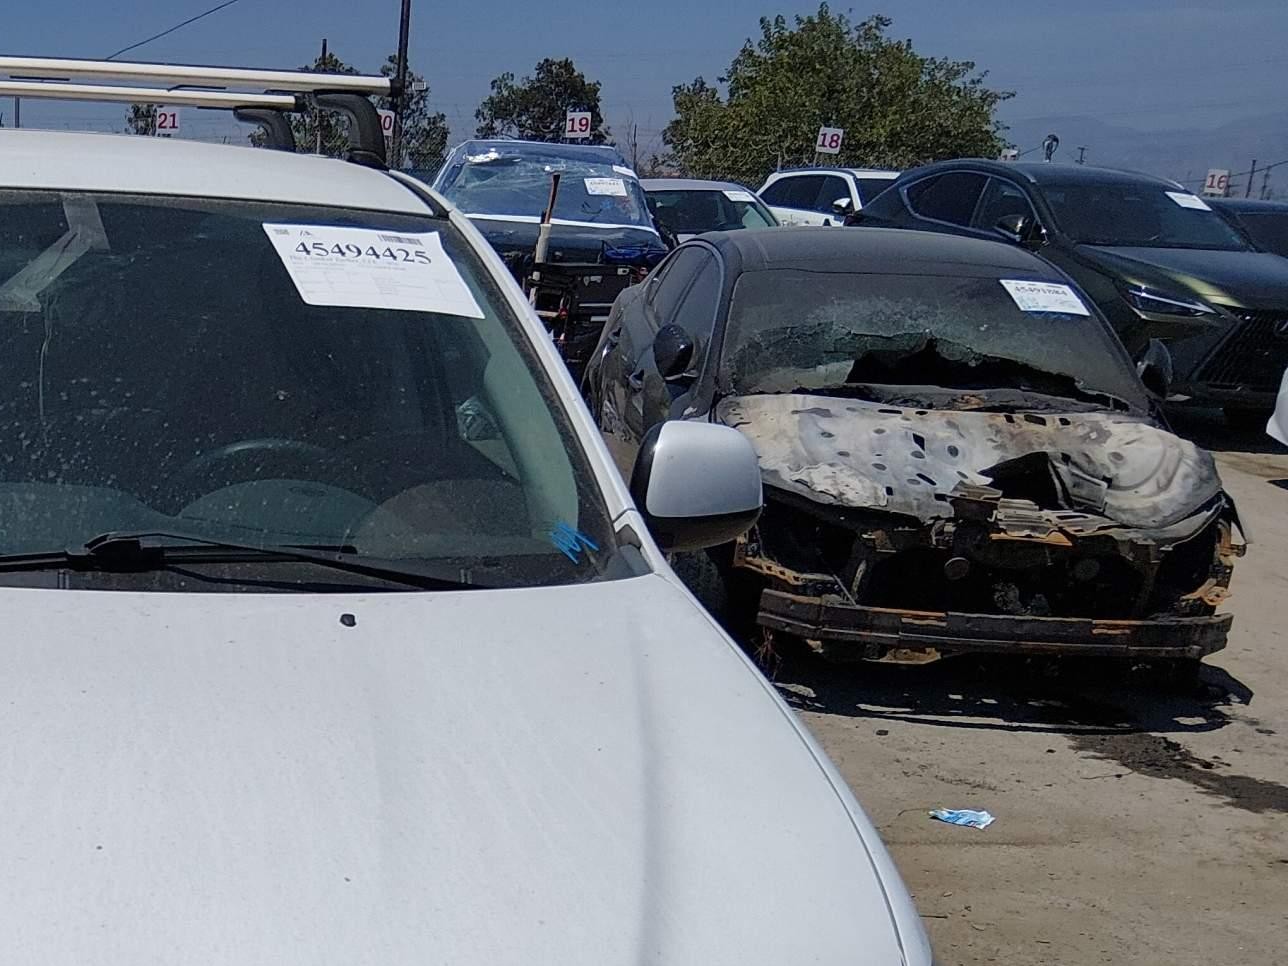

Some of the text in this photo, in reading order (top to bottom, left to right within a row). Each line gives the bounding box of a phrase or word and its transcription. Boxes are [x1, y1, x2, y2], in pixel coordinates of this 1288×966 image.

[158, 113, 178, 129] 21
[567, 117, 589, 133] 19
[818, 132, 840, 149] 18
[1207, 174, 1228, 190] 16
[295, 241, 432, 265] 45494425
